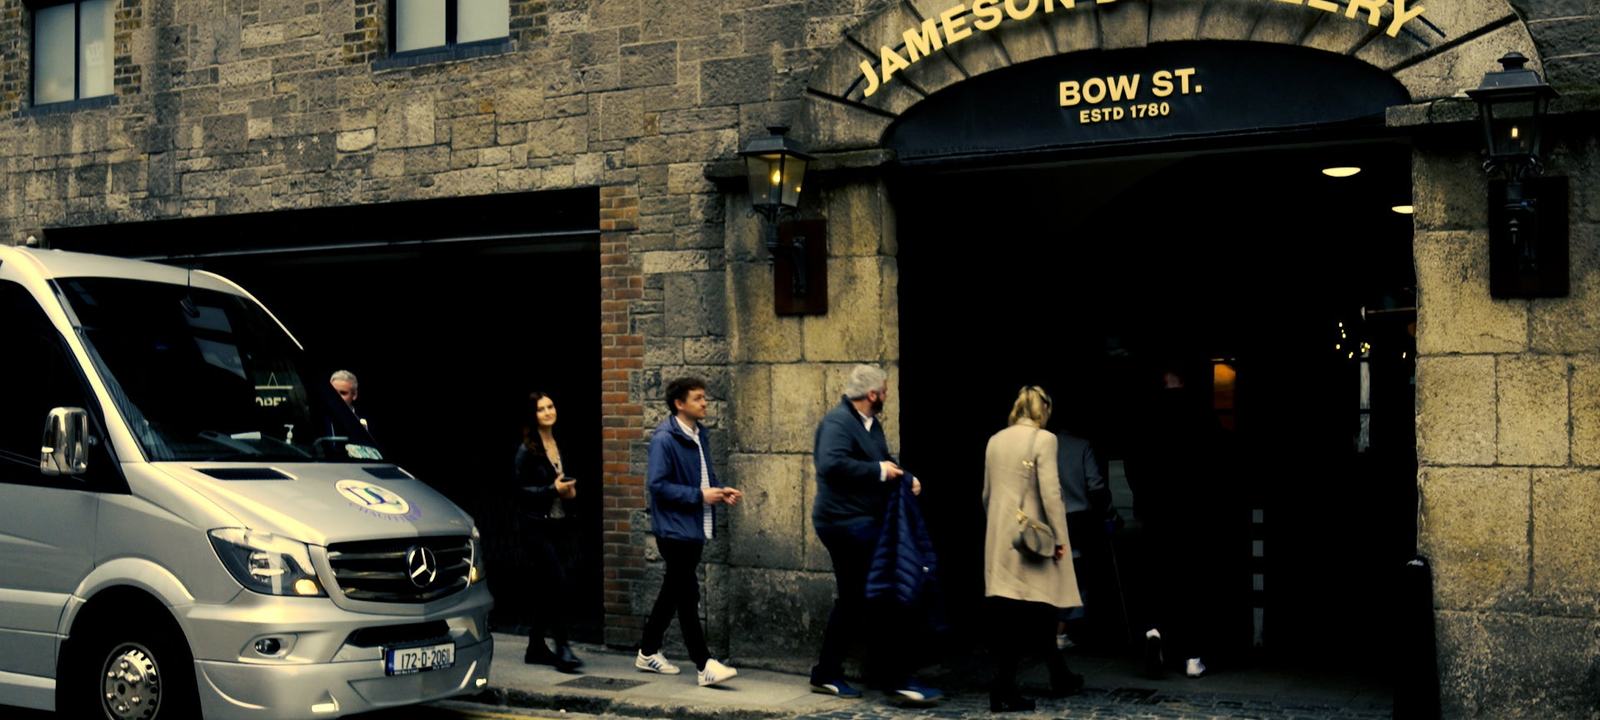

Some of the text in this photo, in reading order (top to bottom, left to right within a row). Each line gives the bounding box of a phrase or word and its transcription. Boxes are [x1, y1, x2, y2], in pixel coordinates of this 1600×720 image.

[1059, 68, 1204, 107] BOW ST.
[1079, 102, 1170, 123] ESTD 1780
[255, 396, 287, 407] OPE
